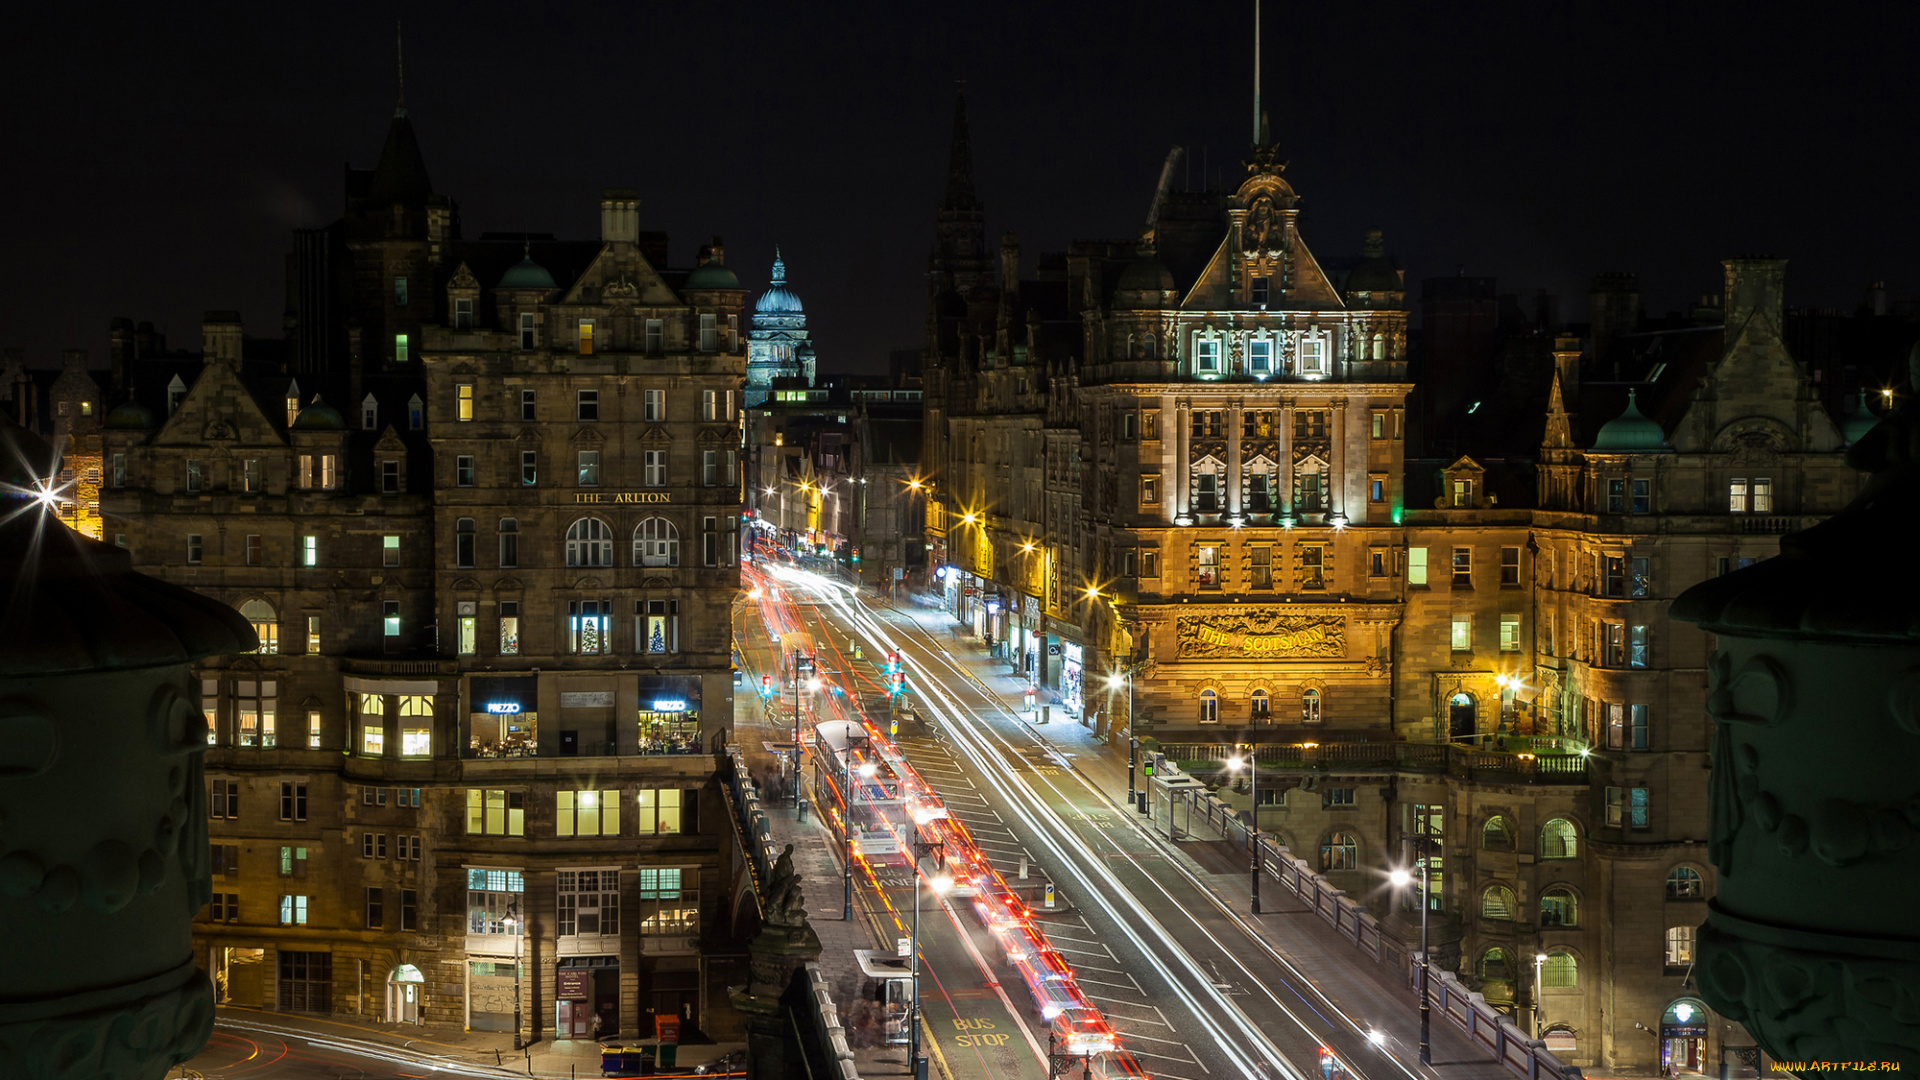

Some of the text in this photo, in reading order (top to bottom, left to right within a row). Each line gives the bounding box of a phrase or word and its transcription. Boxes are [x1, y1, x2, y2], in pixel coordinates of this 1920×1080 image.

[575, 493, 602, 503] THE
[1201, 626, 1324, 651] THE SCOTSMAN
[488, 703, 520, 713] PREZZO
[952, 1018, 996, 1031] BUS
[955, 1033, 1010, 1048] STOP
